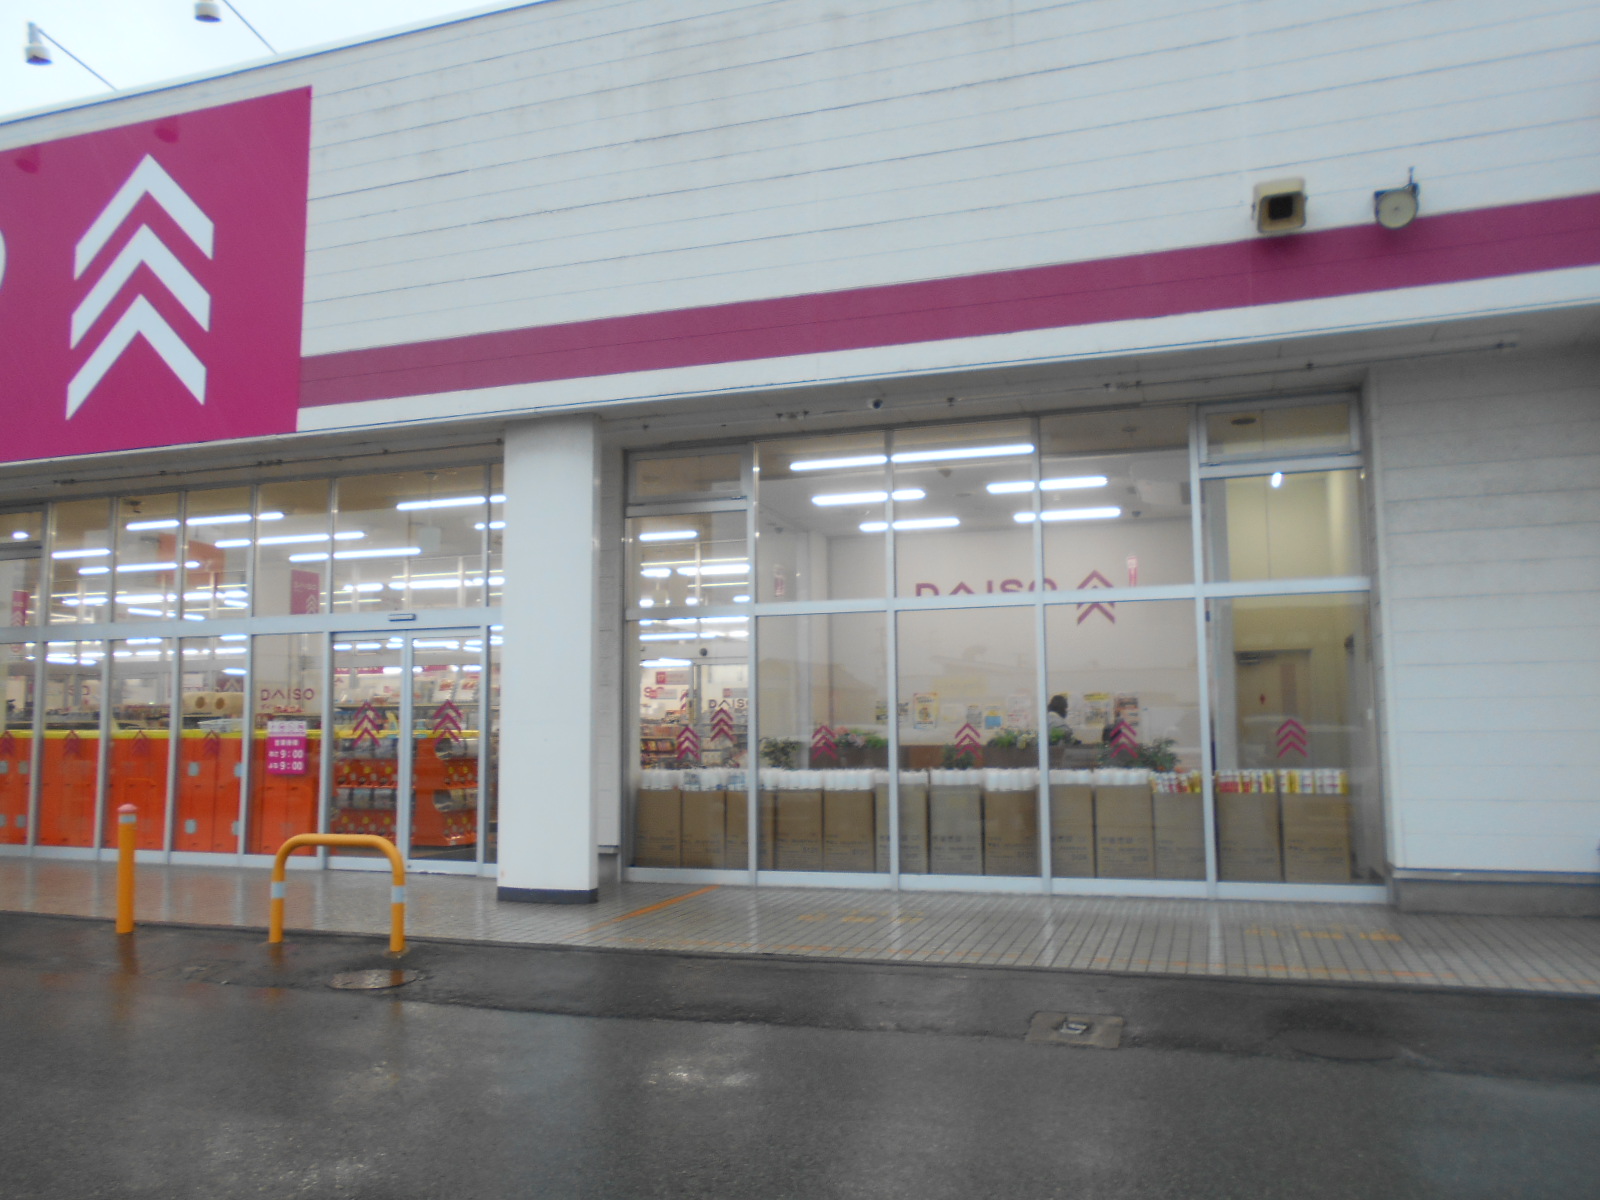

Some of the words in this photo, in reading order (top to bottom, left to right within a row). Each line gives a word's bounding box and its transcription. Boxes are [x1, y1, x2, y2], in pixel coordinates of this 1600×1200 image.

[261, 689, 314, 701] DAISO
[708, 698, 749, 709] DAIS
[279, 749, 304, 759] 9:00
[279, 761, 304, 771] 9:00
